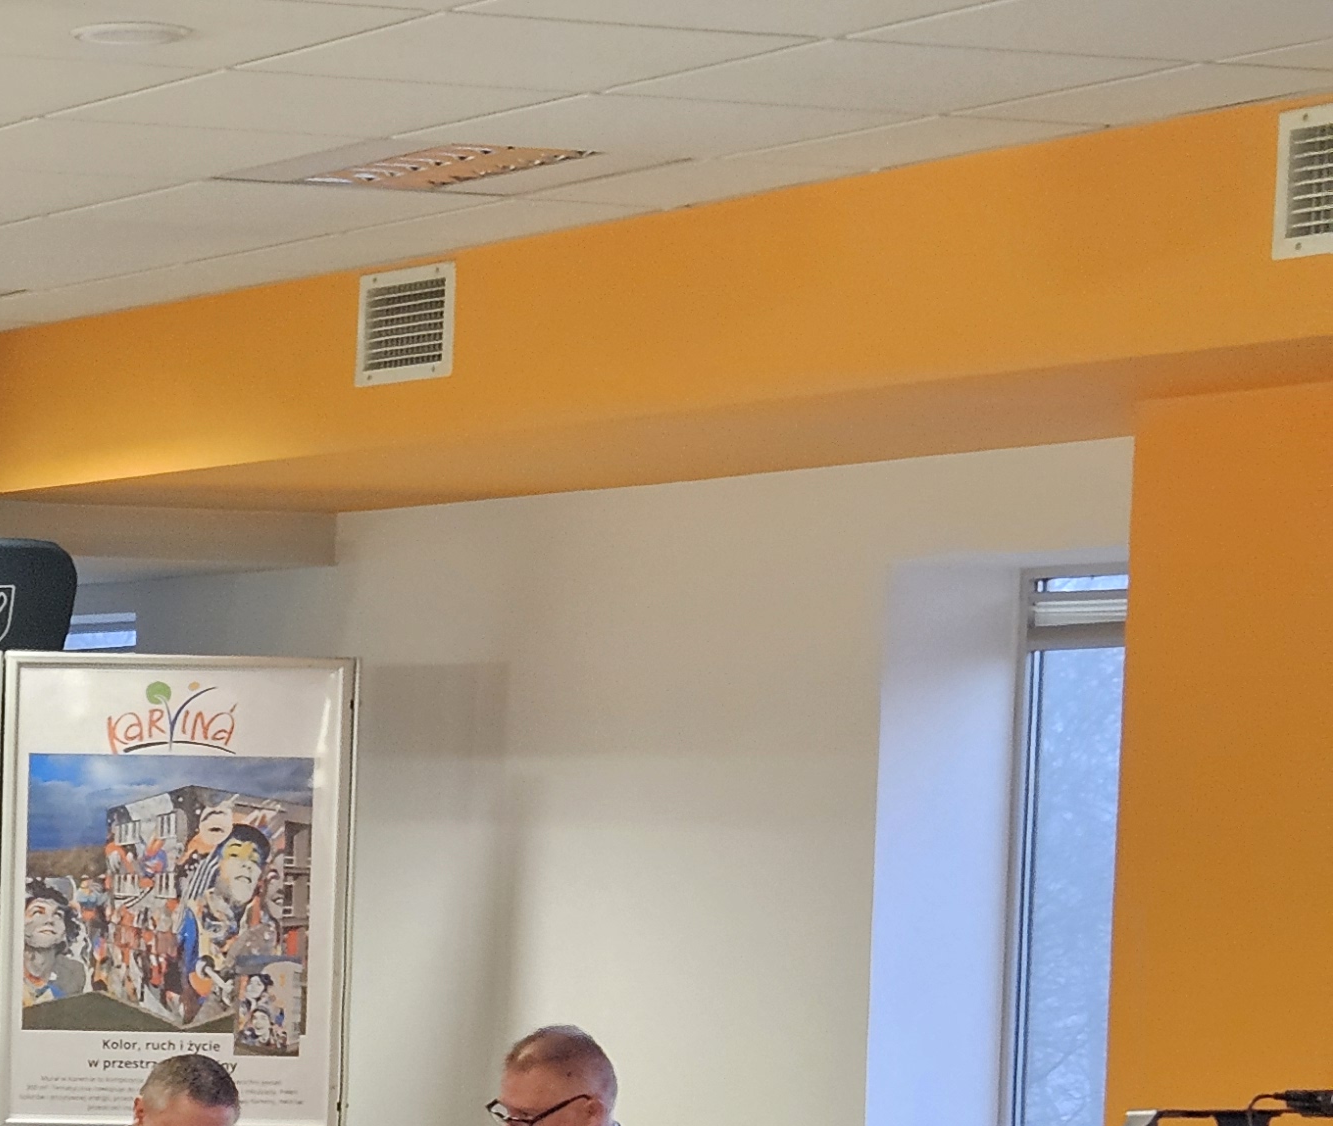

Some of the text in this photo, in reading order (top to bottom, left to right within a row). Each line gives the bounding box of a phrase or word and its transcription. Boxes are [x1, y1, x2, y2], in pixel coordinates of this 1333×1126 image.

[145, 1040, 176, 1052] ruch
[188, 1041, 221, 1055] życie
[87, 1058, 158, 1071] w przestr
